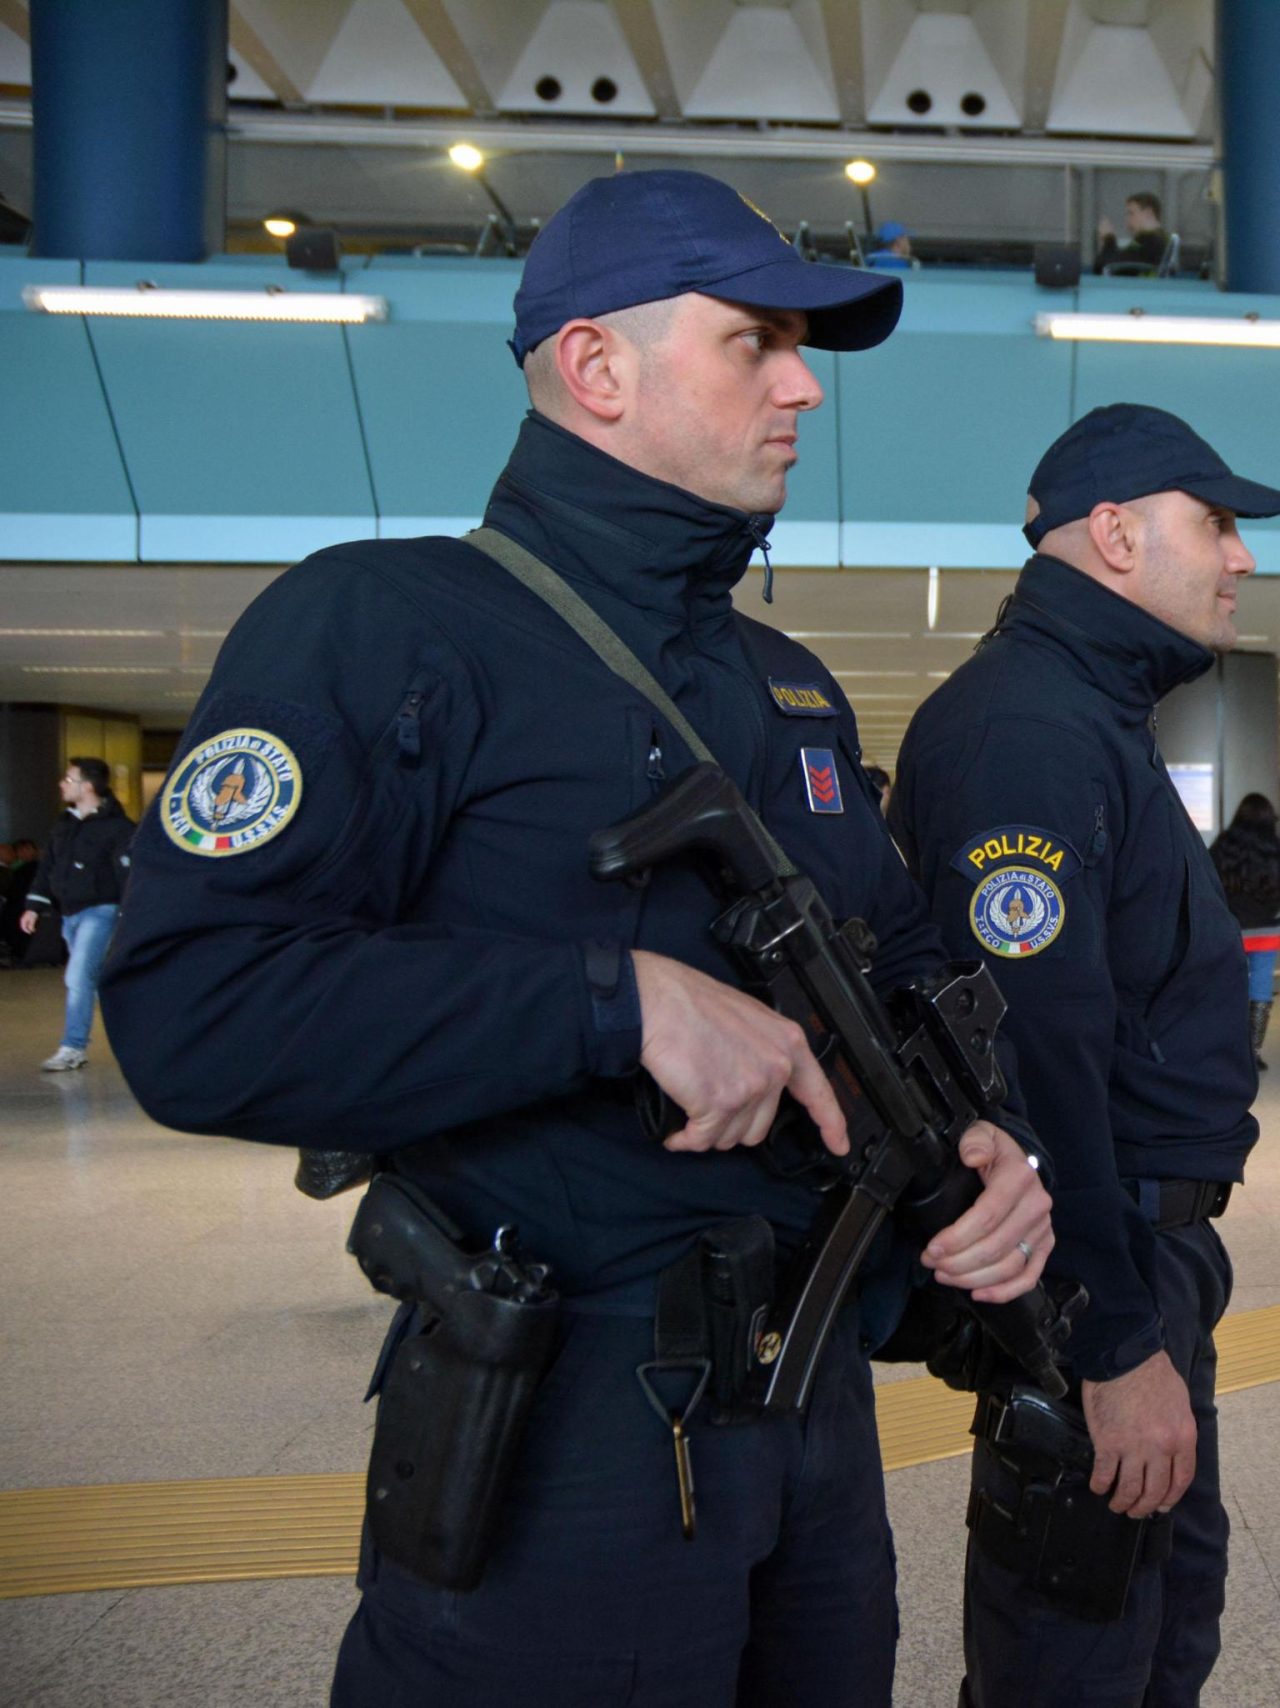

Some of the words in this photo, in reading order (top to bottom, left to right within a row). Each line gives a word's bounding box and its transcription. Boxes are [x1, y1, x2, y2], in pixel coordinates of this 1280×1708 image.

[772, 686, 831, 708] POLIZIA
[195, 735, 250, 765] POLIZIA
[260, 739, 293, 782] STATO
[968, 834, 1063, 871] POLIZIA
[981, 871, 1018, 897] POLIZIA
[1027, 874, 1055, 898] STATO
[980, 928, 1000, 948] FCO
